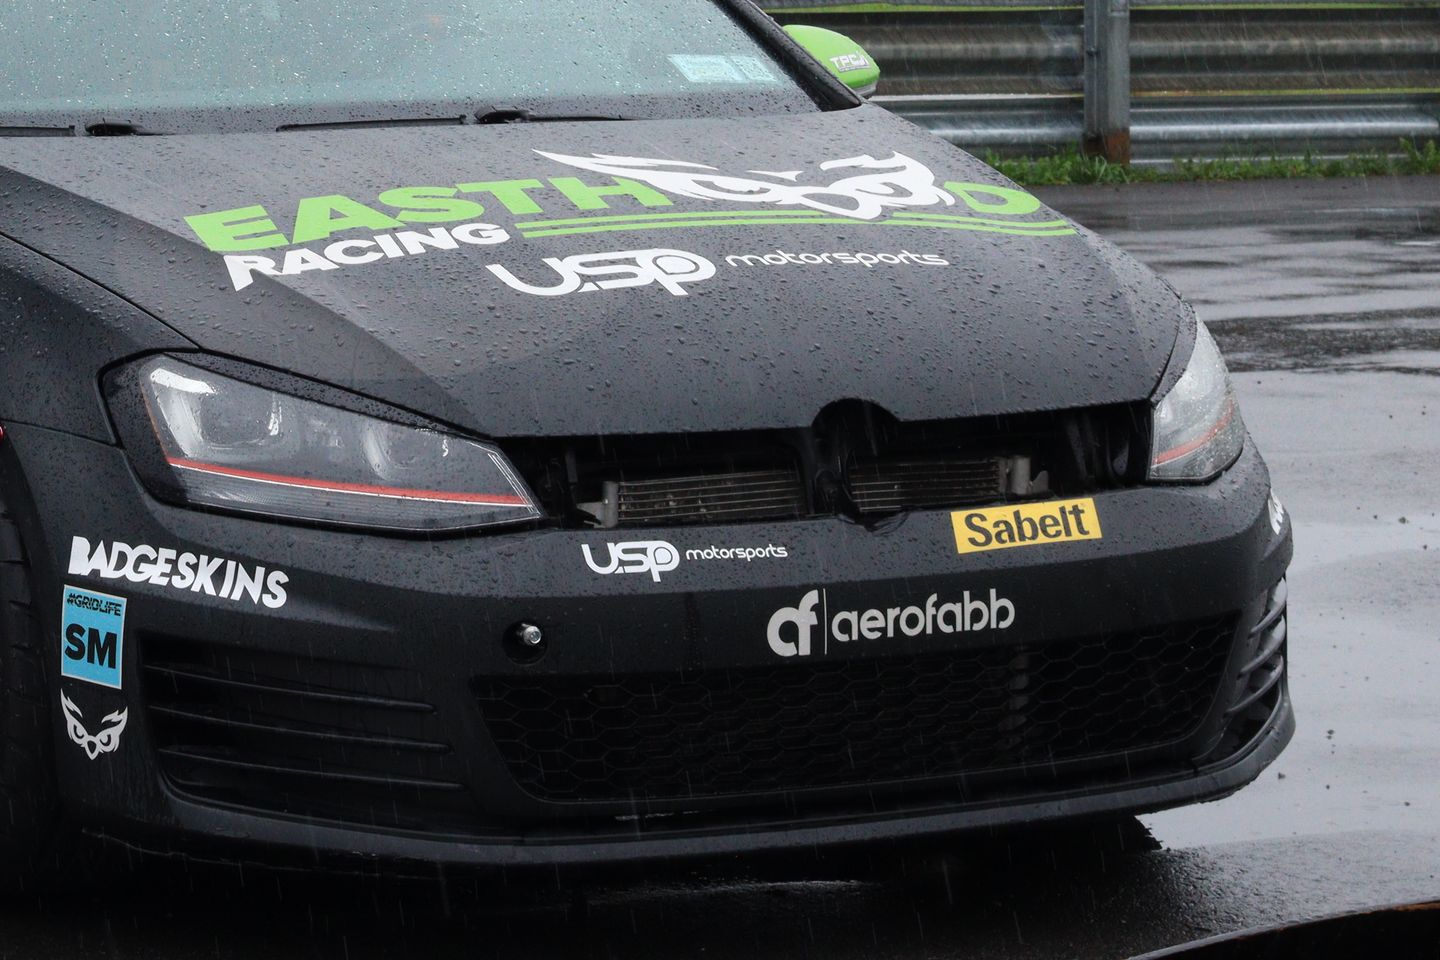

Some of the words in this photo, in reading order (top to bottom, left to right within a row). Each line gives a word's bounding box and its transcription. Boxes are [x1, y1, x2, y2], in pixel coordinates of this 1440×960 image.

[224, 221, 511, 291] RACING
[725, 250, 950, 268] motorsports
[963, 502, 1091, 548] Sabelt
[68, 536, 289, 609] BADGESKINS
[686, 543, 788, 561] motorsports
[67, 593, 122, 617] #GRIDLIFE
[831, 588, 1015, 642] aerofabb
[65, 624, 117, 669] SM
